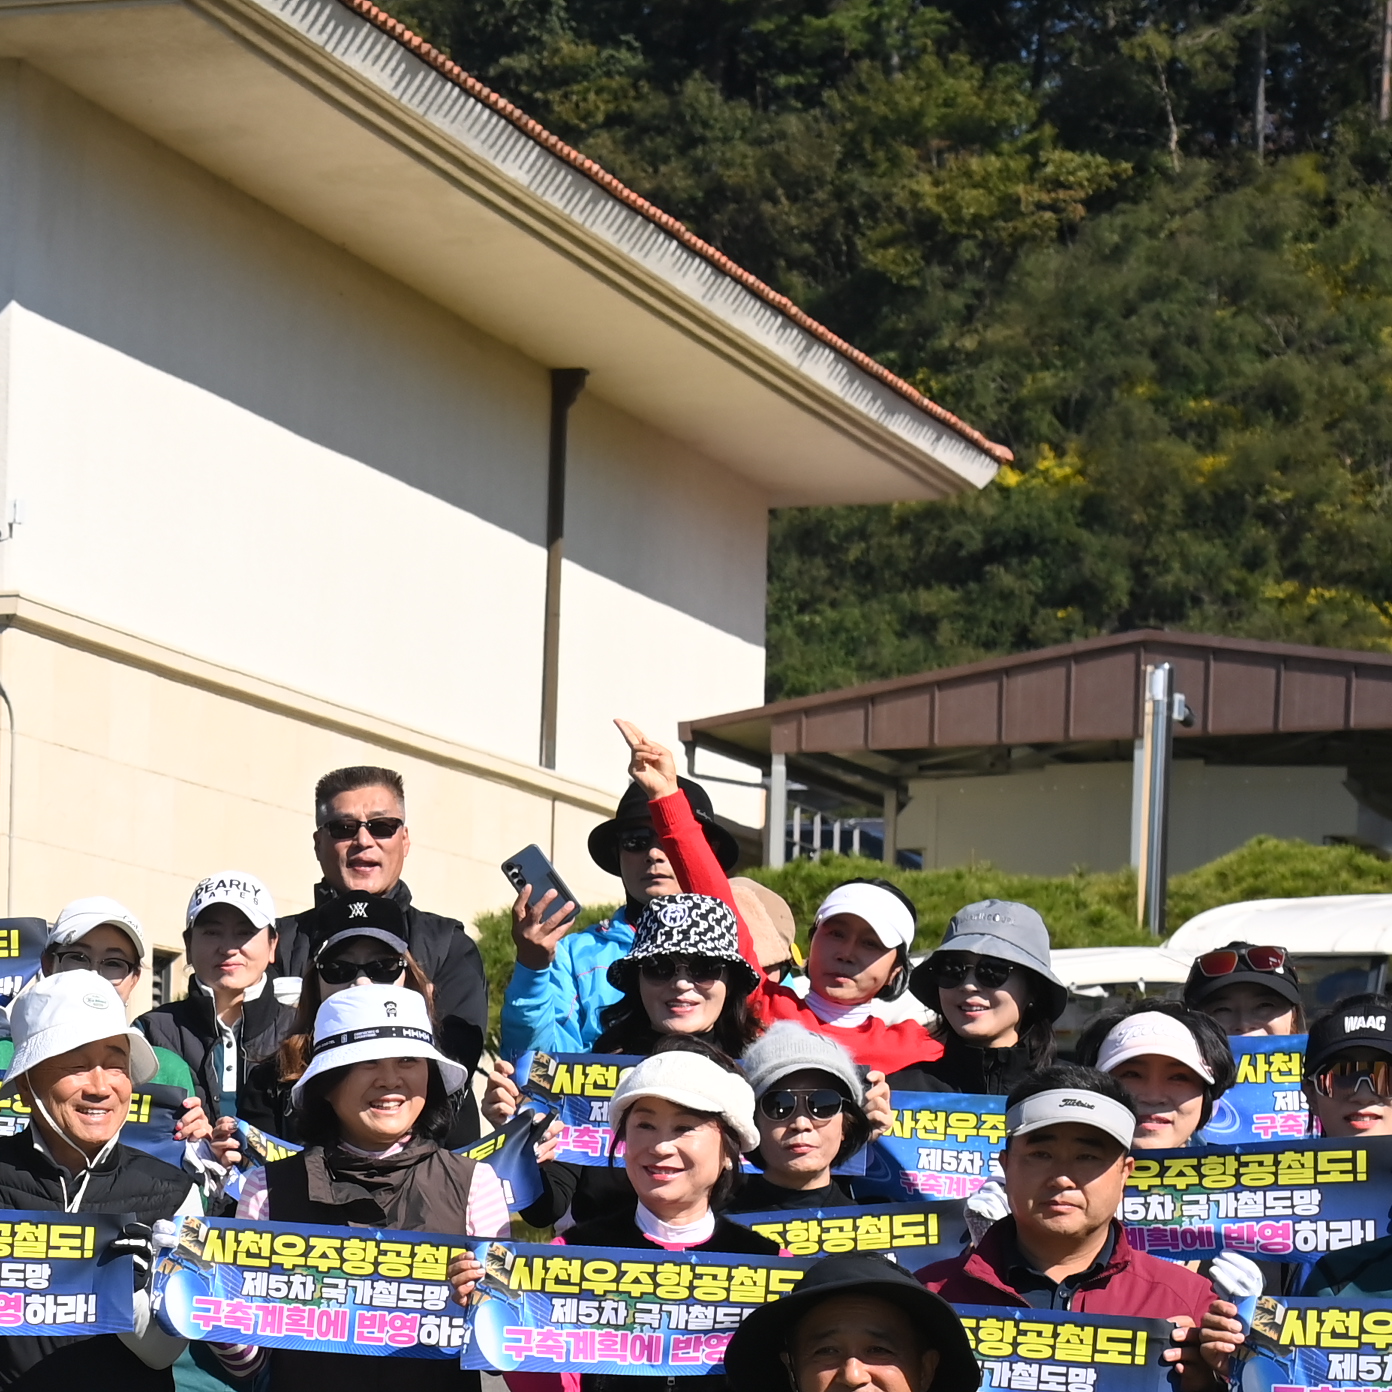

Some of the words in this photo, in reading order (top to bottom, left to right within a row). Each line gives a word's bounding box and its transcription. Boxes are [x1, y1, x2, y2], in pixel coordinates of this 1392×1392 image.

[1344, 1015, 1387, 1034] WAAC
[918, 1147, 983, 1174] 제5차
[1182, 1189, 1322, 1219] 국가철도망
[241, 1271, 314, 1300] 제5차
[322, 1277, 449, 1310] 국가철도망
[191, 1297, 347, 1342] 구축계획에
[551, 1298, 627, 1327] 제5차
[503, 1326, 662, 1366] 구축계획에
